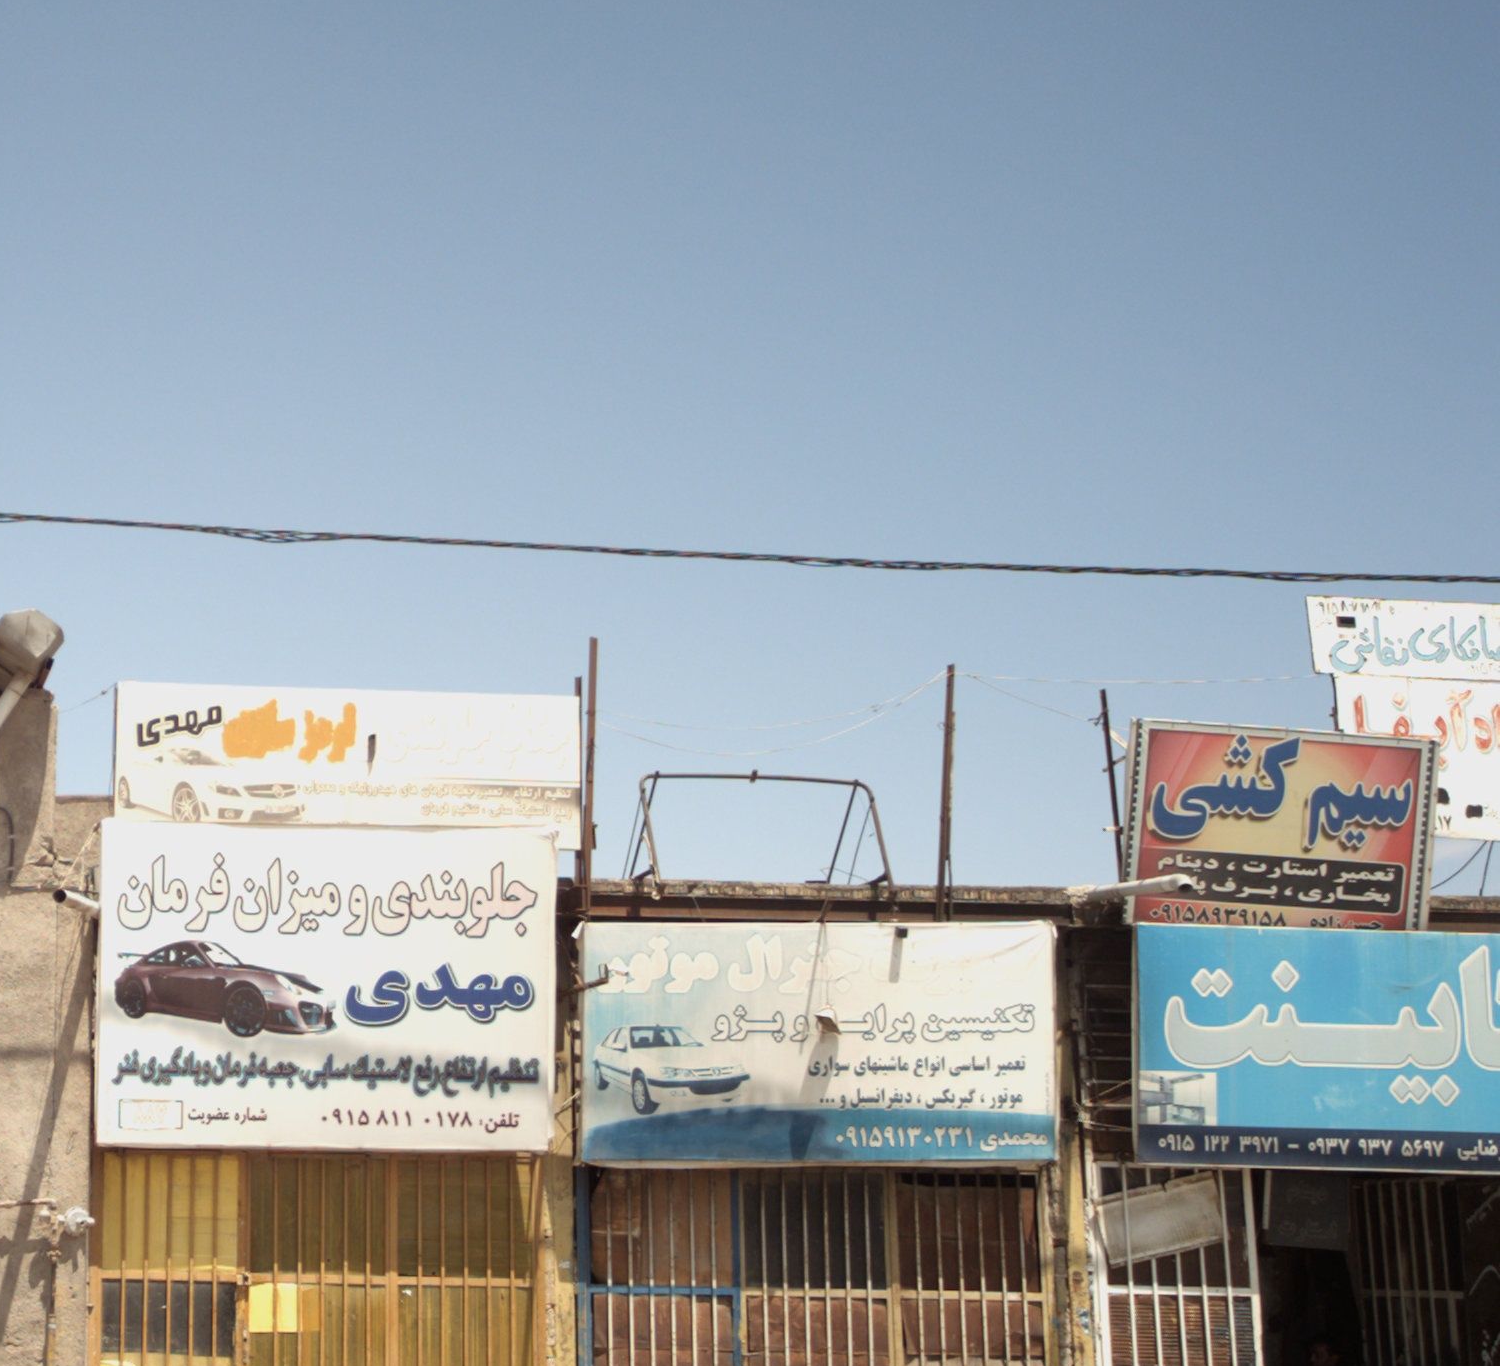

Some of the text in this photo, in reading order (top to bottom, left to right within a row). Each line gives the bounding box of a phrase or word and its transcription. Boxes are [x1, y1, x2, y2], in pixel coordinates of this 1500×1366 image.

[1408, 616, 1500, 663] افکاری
[135, 704, 223, 748] مهدی
[1148, 733, 1414, 853] سیم کشی
[1157, 852, 1396, 885] تعمیر استارت دینام
[116, 852, 538, 938] جلوبندی و میزان فرمان
[1211, 875, 1277, 898] برف
[1297, 885, 1391, 906] بخاری
[345, 962, 534, 1026] مهدی
[711, 1004, 786, 1043] پژو
[790, 1014, 809, 1042] و
[921, 1003, 1035, 1042] تکنیسین
[1164, 945, 1500, 1107] ابینت
[807, 1054, 1027, 1078] تعمیر اساسی انواع ماشینهای سواری
[850, 1087, 912, 1110] دیفرانسیل
[925, 1086, 977, 1110] گیربکس
[988, 1087, 1023, 1110] موتور
[187, 1107, 231, 1125] عضویت
[234, 1106, 268, 1125] شماره
[321, 1108, 369, 1126] ۰۹۱۵
[376, 1110, 412, 1127] ۸۱۱
[423, 1110, 472, 1128] ۰۱۷۸
[979, 1131, 1049, 1153] محمدی
[1457, 1139, 1500, 1161] ضایی
